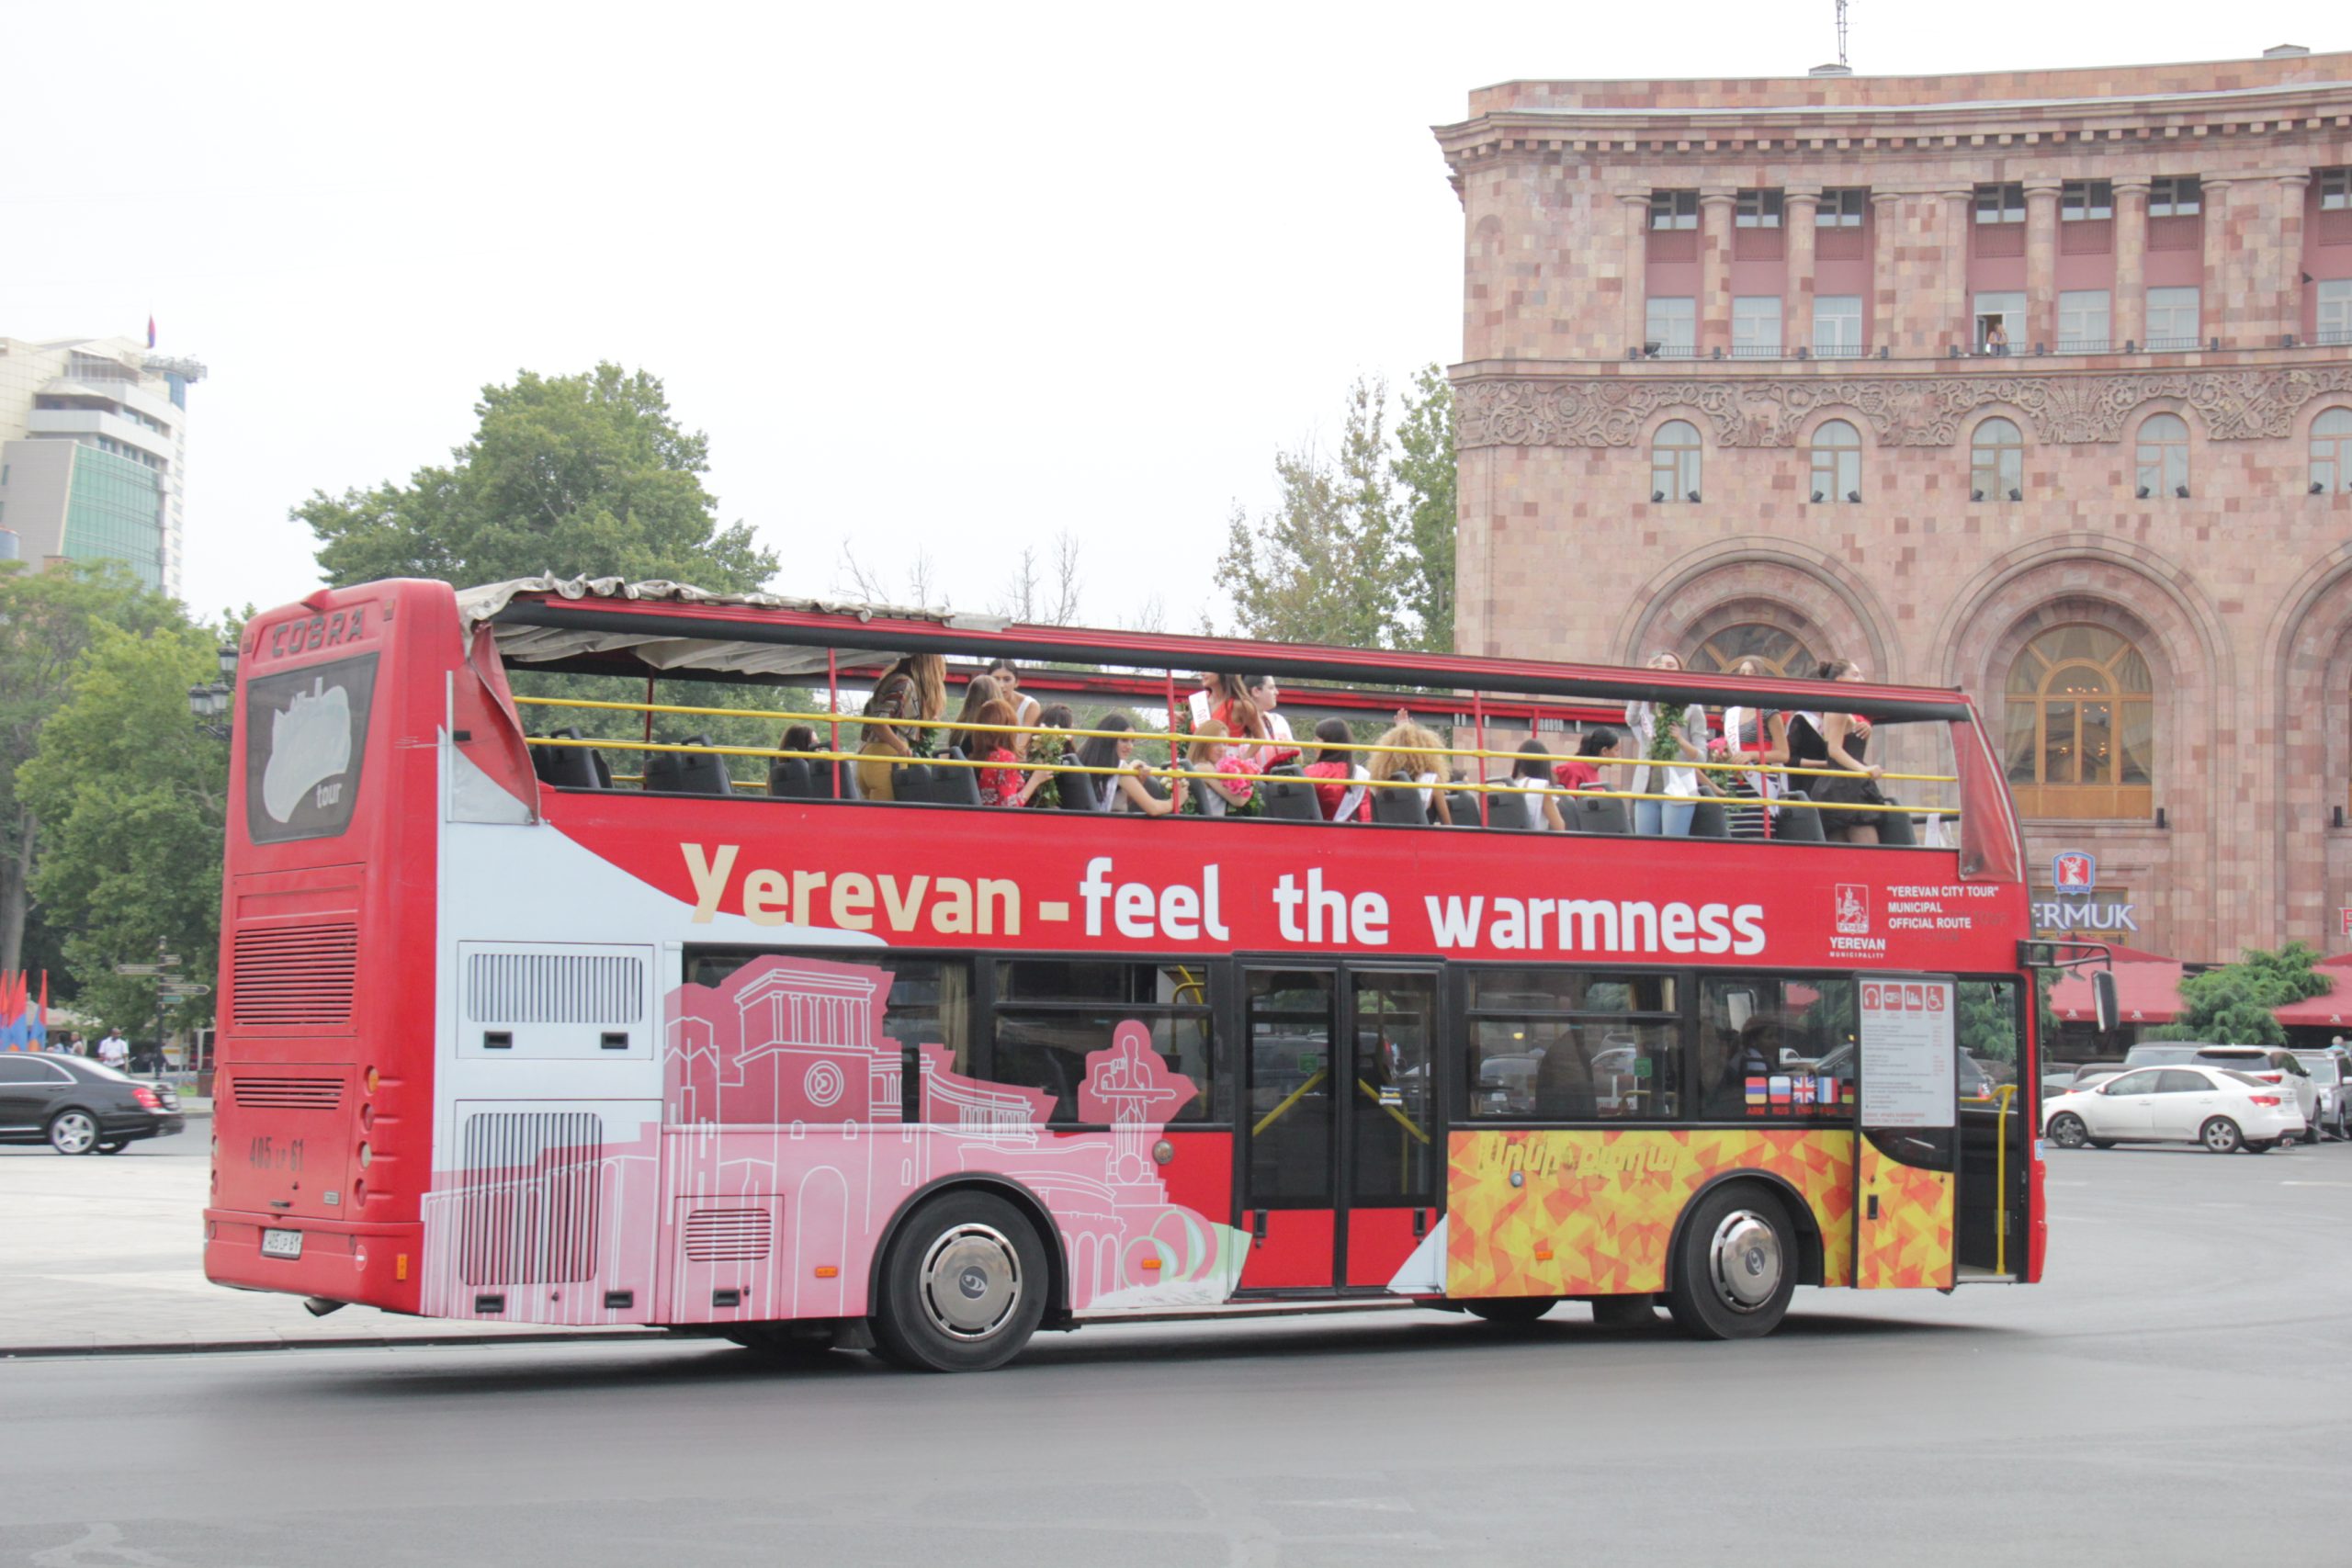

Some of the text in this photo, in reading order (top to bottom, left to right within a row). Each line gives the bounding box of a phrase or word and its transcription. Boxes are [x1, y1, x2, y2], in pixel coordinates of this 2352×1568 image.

[271, 609, 364, 657] COBRA
[316, 783, 343, 808] tour
[1886, 886, 1999, 897] "YEREVAN CITY TOUR"
[1079, 856, 1229, 942] feel
[1272, 867, 1389, 946] the
[1424, 895, 1766, 955] warmness
[1887, 901, 1943, 913] MUNICIPAL
[1888, 917, 1935, 929] OFFICIAL
[1937, 917, 1972, 929] ROUTE
[1829, 936, 1886, 950] YEREVAN
[1829, 951, 1884, 959] MUNICIPALITY
